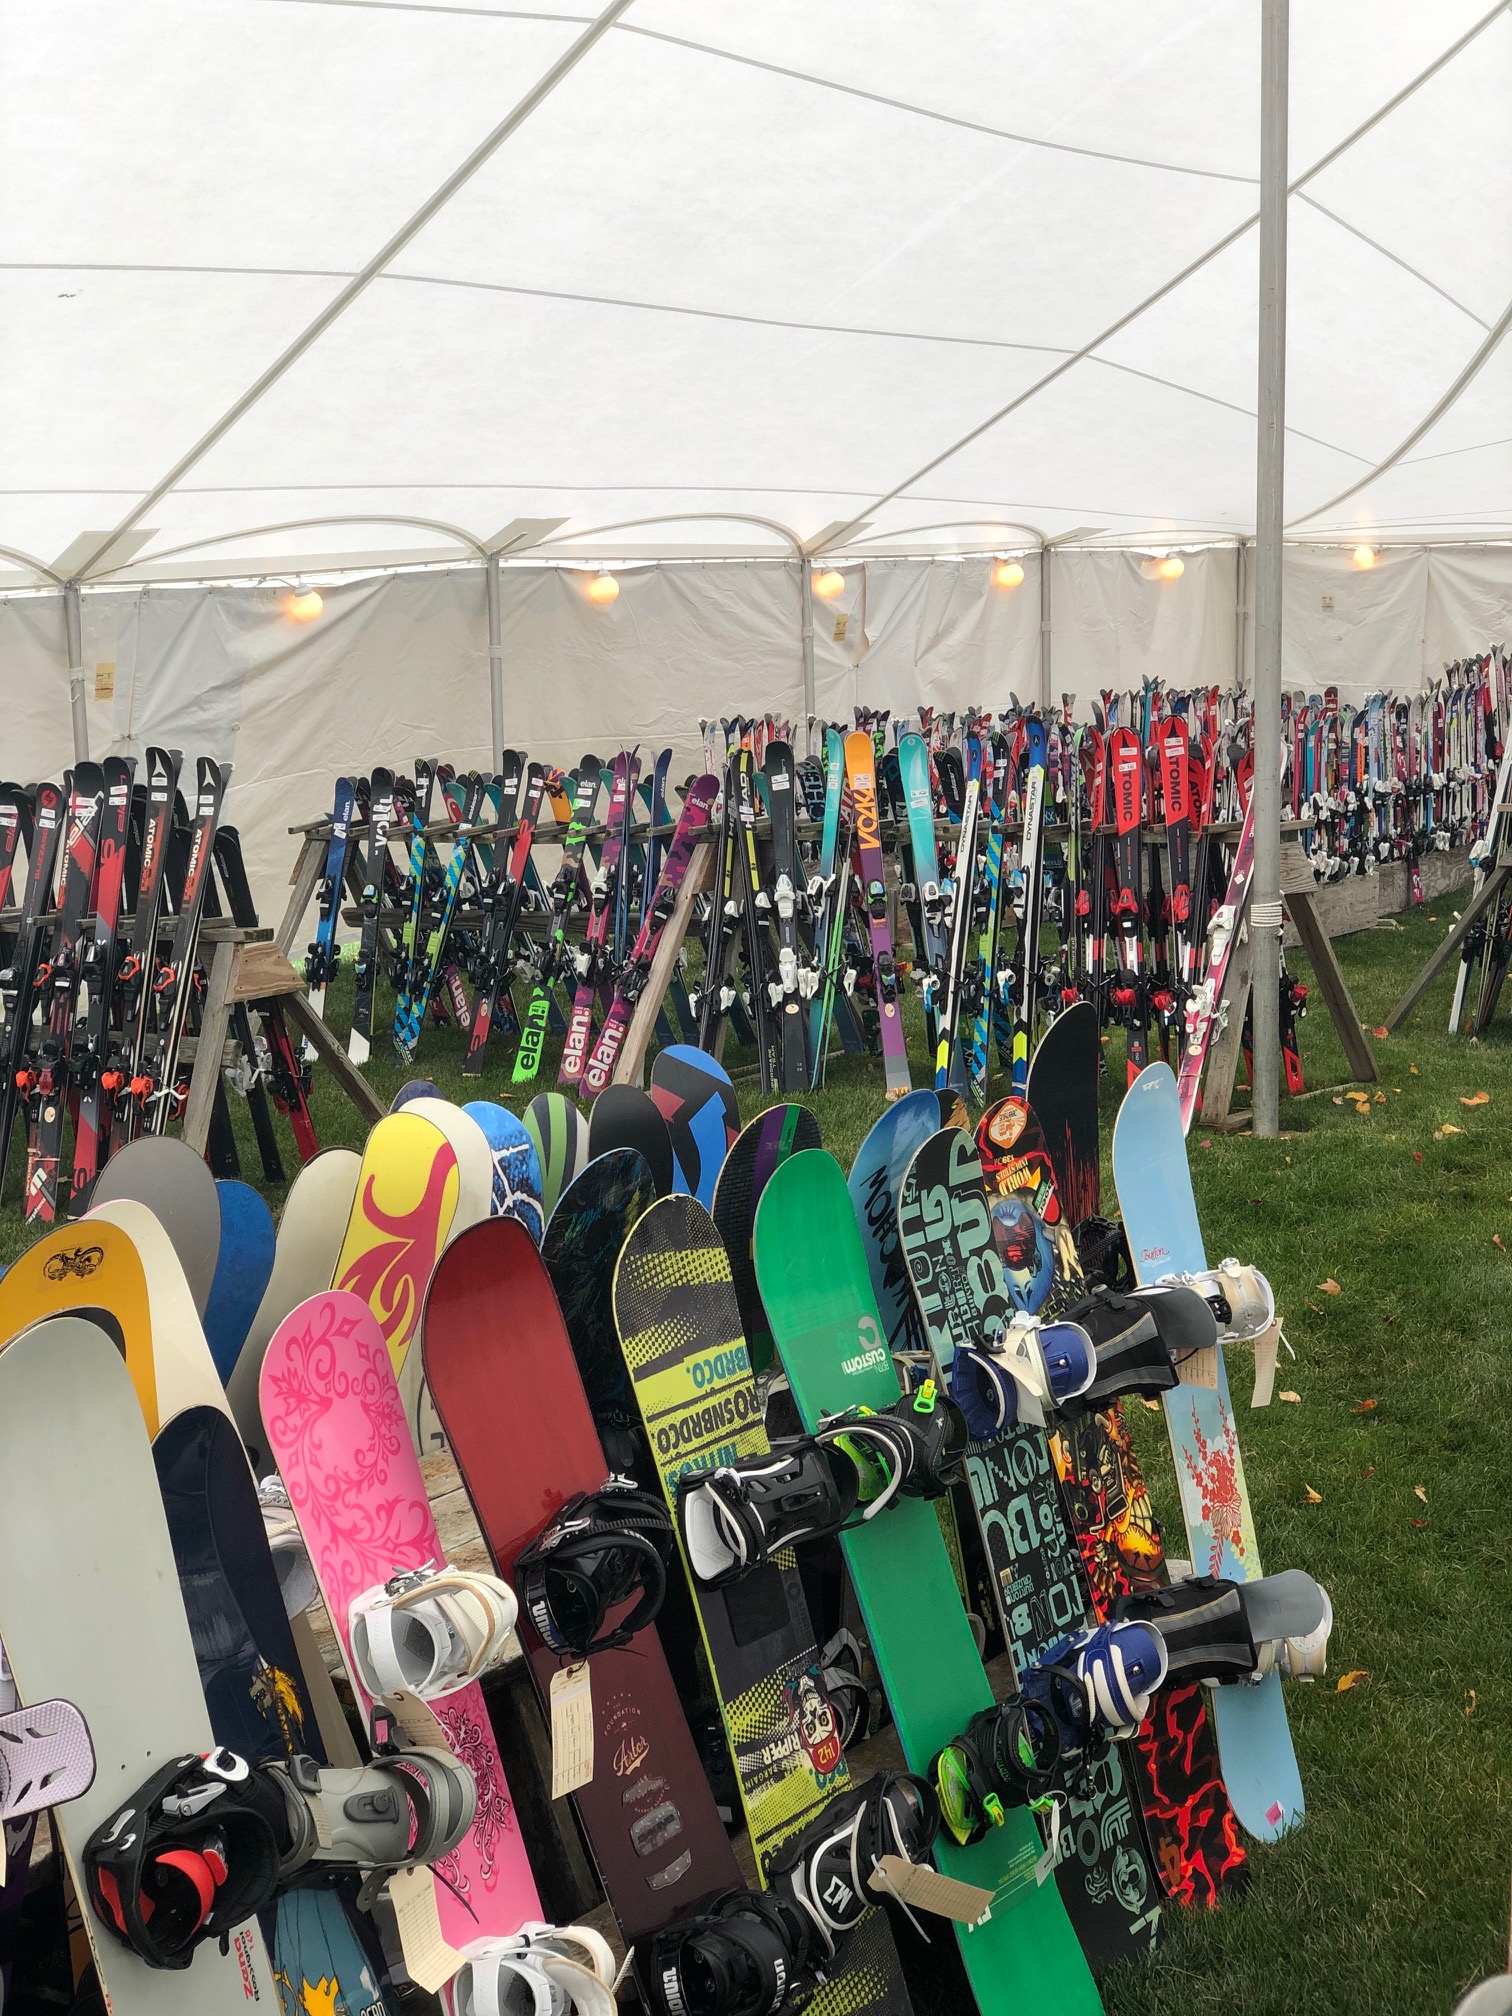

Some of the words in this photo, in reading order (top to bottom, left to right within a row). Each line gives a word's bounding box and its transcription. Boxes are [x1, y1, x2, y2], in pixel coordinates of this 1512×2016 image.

[580, 780, 598, 788] elan.
[691, 797, 710, 812] elan.
[1168, 757, 1182, 812] TOMIC
[343, 799, 352, 822] elan.
[960, 794, 973, 852] DYNASTAR
[1026, 781, 1037, 840] DYNASTAR
[144, 818, 156, 868] ATOMIC
[188, 828, 202, 877] ATOMIC
[520, 1010, 547, 1071] elan.
[564, 1009, 590, 1074] elan.
[588, 1026, 624, 1088] elan.
[999, 1166, 1032, 1197] WORLD
[604, 1707, 641, 1736] FOUNDATION
[613, 1736, 650, 1777] Arbor
[762, 1730, 800, 1766] RIPPER
[817, 1742, 835, 1764] 142
[233, 1936, 254, 2000] Zena
